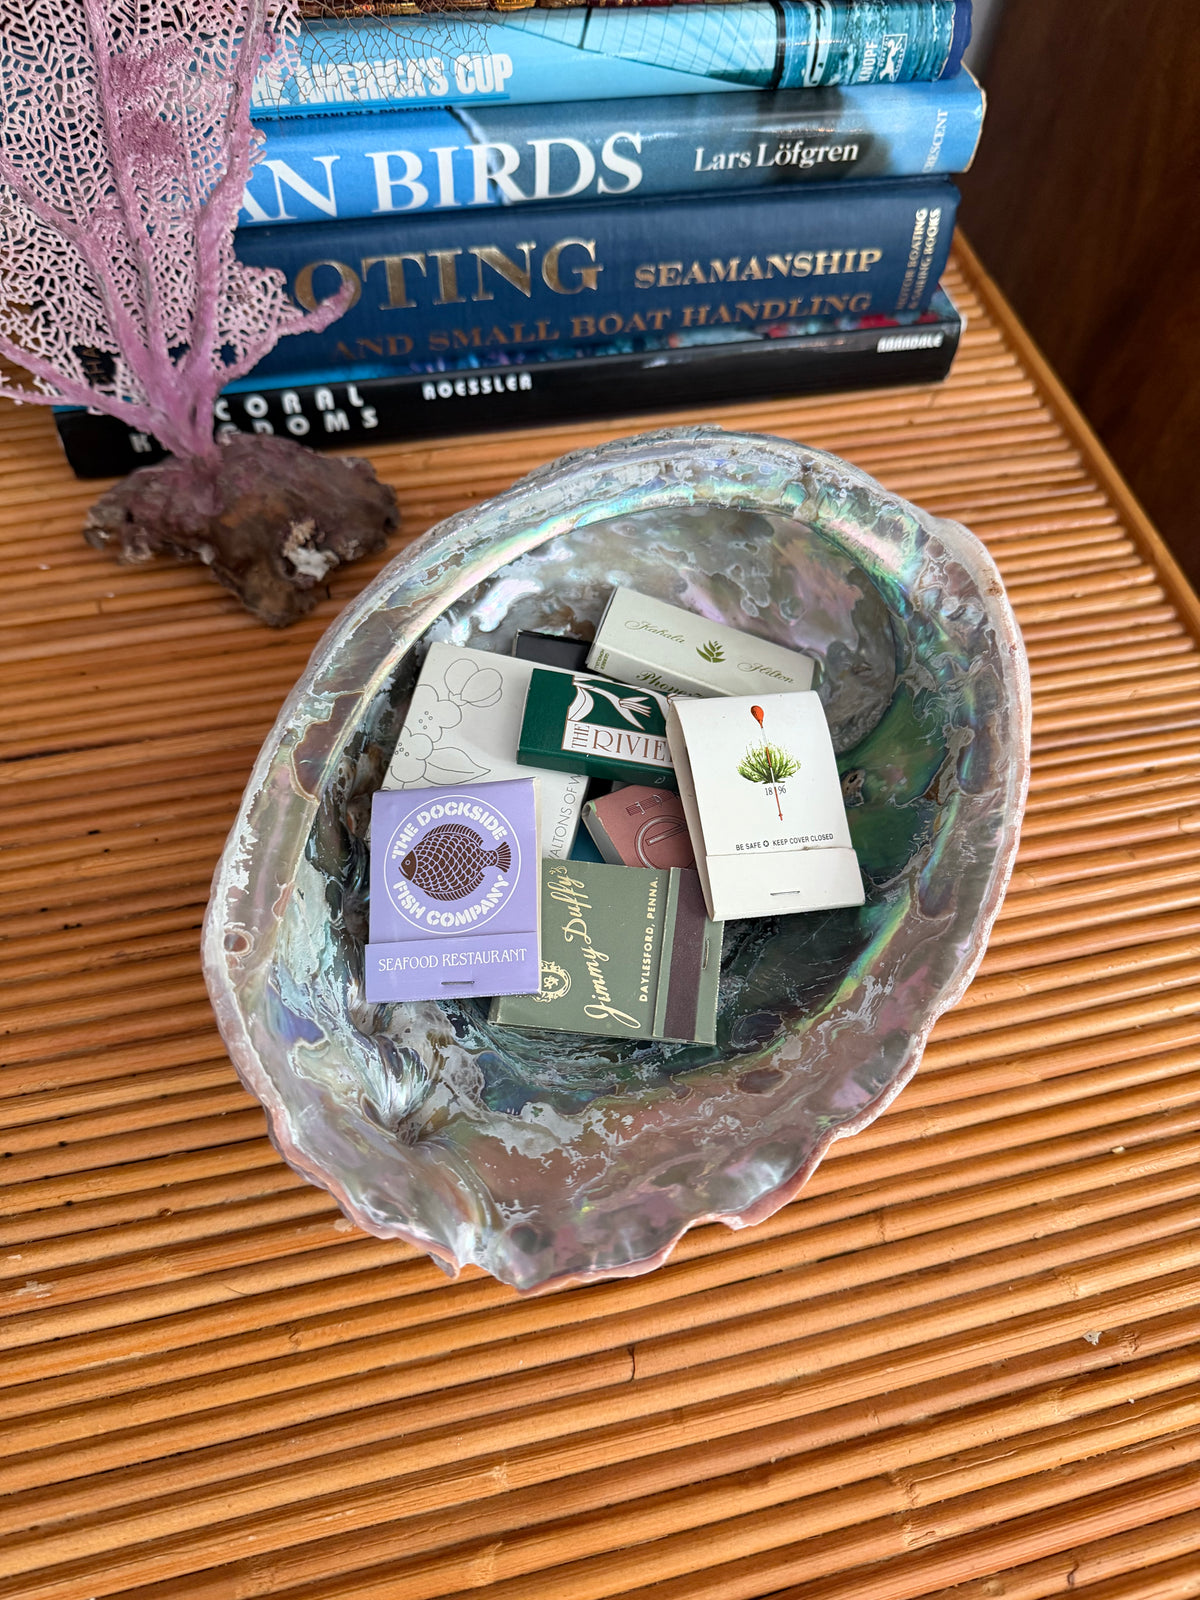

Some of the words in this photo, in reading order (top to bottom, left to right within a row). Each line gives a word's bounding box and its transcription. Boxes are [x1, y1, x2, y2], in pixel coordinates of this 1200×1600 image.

[297, 58, 449, 104] AMERICA'S
[454, 54, 513, 95] CUP
[857, 41, 878, 82] KNOPF
[694, 147, 752, 172] Lars
[756, 140, 859, 169] Löfgren
[922, 108, 948, 173] CRESCENT
[364, 131, 644, 214] BIRDS
[907, 207, 928, 268] BOATING
[923, 207, 942, 256] BOOKS
[293, 237, 604, 317] OTING
[634, 248, 882, 290] SEAMANSHIP
[334, 334, 414, 361] AND
[429, 320, 559, 351] SMALL
[571, 309, 672, 338] BOAT
[680, 292, 873, 329] HANDLING
[214, 384, 364, 421] CORAL
[422, 371, 533, 401] ROESSLER
[624, 620, 686, 644] Kahala
[736, 662, 795, 684] Hilton
[571, 723, 590, 748] THE
[592, 728, 673, 764] RIVIE
[563, 786, 577, 804] OF
[391, 822, 419, 860] THE
[415, 801, 509, 841] DOCKSIDE
[735, 843, 745, 851] BE
[745, 841, 762, 850] SAFE
[772, 838, 789, 847] KEEP
[789, 835, 809, 845] COVER
[810, 833, 834, 842] CLOSED
[392, 880, 428, 919] FISH
[426, 874, 510, 927] COMPANY
[646, 876, 659, 919] PENNA.
[378, 954, 439, 972] SEAFOOD
[442, 948, 528, 967] RESTAURANT
[638, 918, 656, 1003] DAYLESFORD,
[583, 945, 641, 1029] Jimmy
